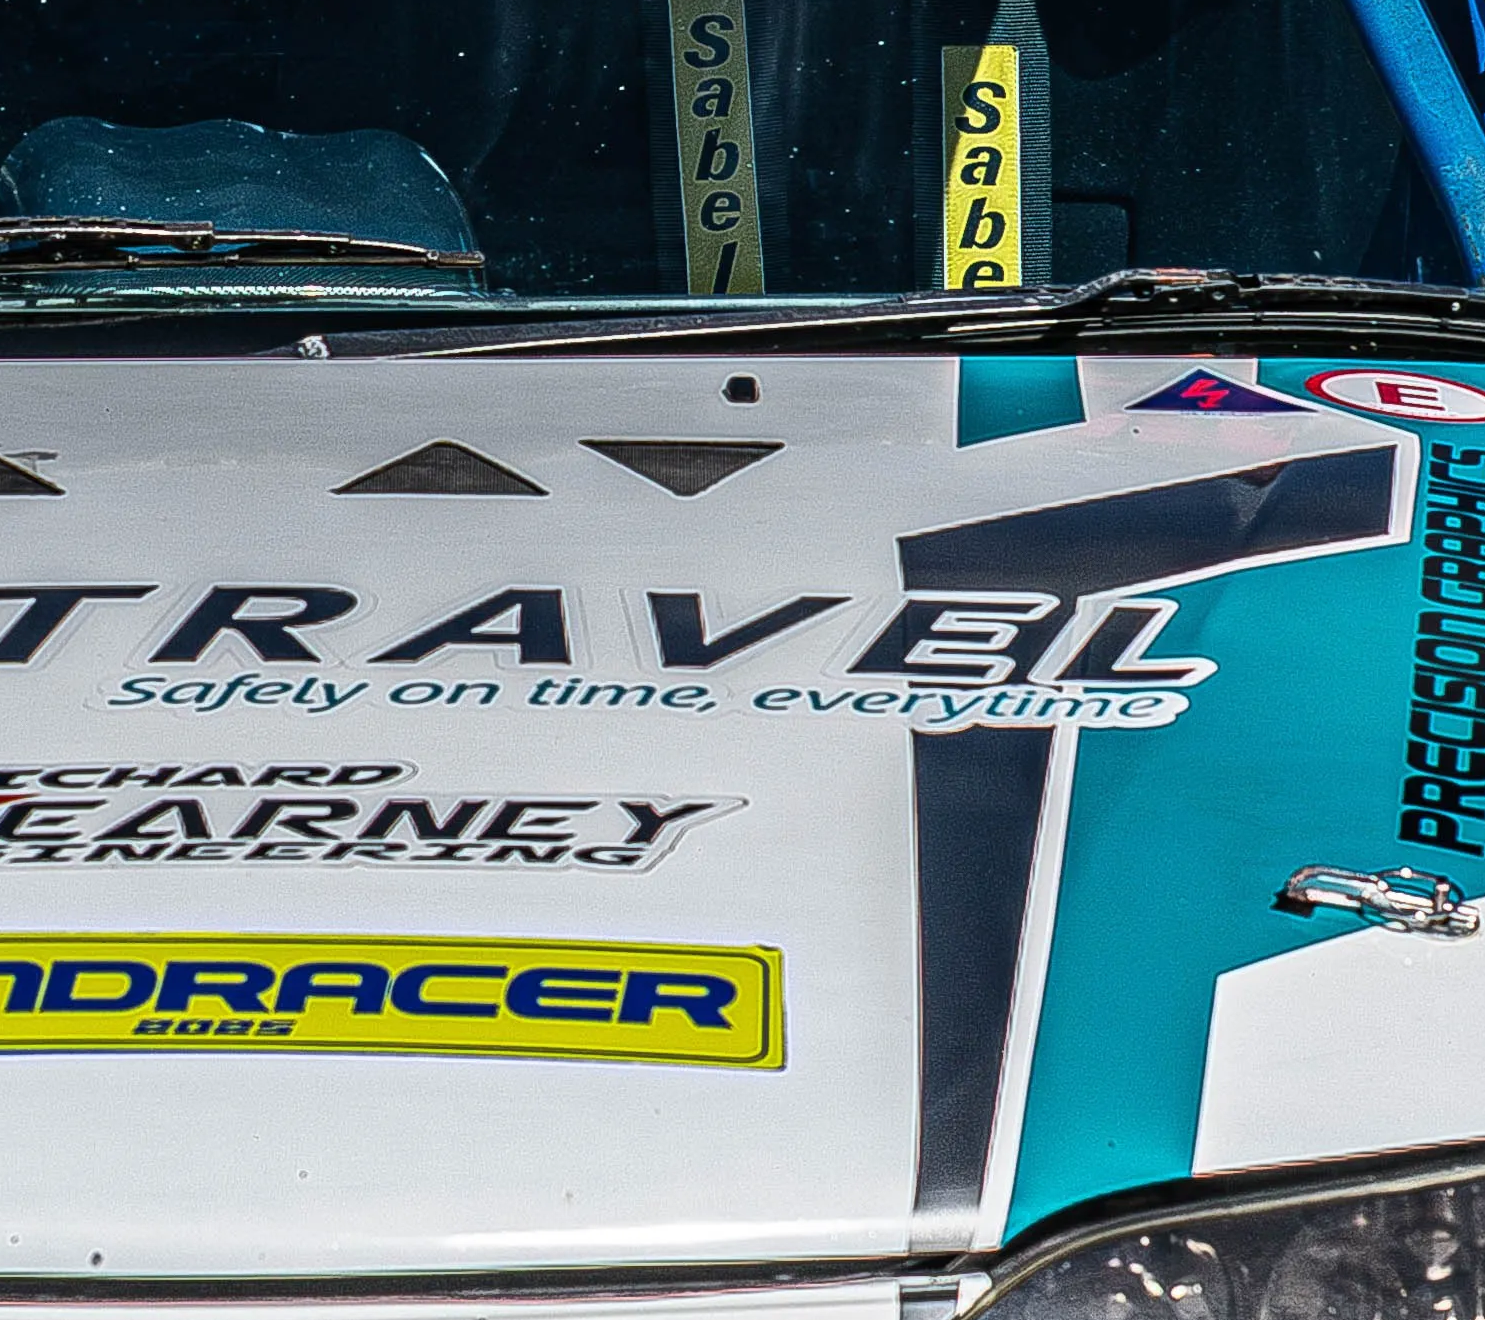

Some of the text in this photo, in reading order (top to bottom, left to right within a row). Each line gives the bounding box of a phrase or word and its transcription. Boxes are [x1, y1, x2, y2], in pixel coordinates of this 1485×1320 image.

[107, 673, 1169, 726] Safely on time, everytime
[131, 1019, 300, 1037] 2025
